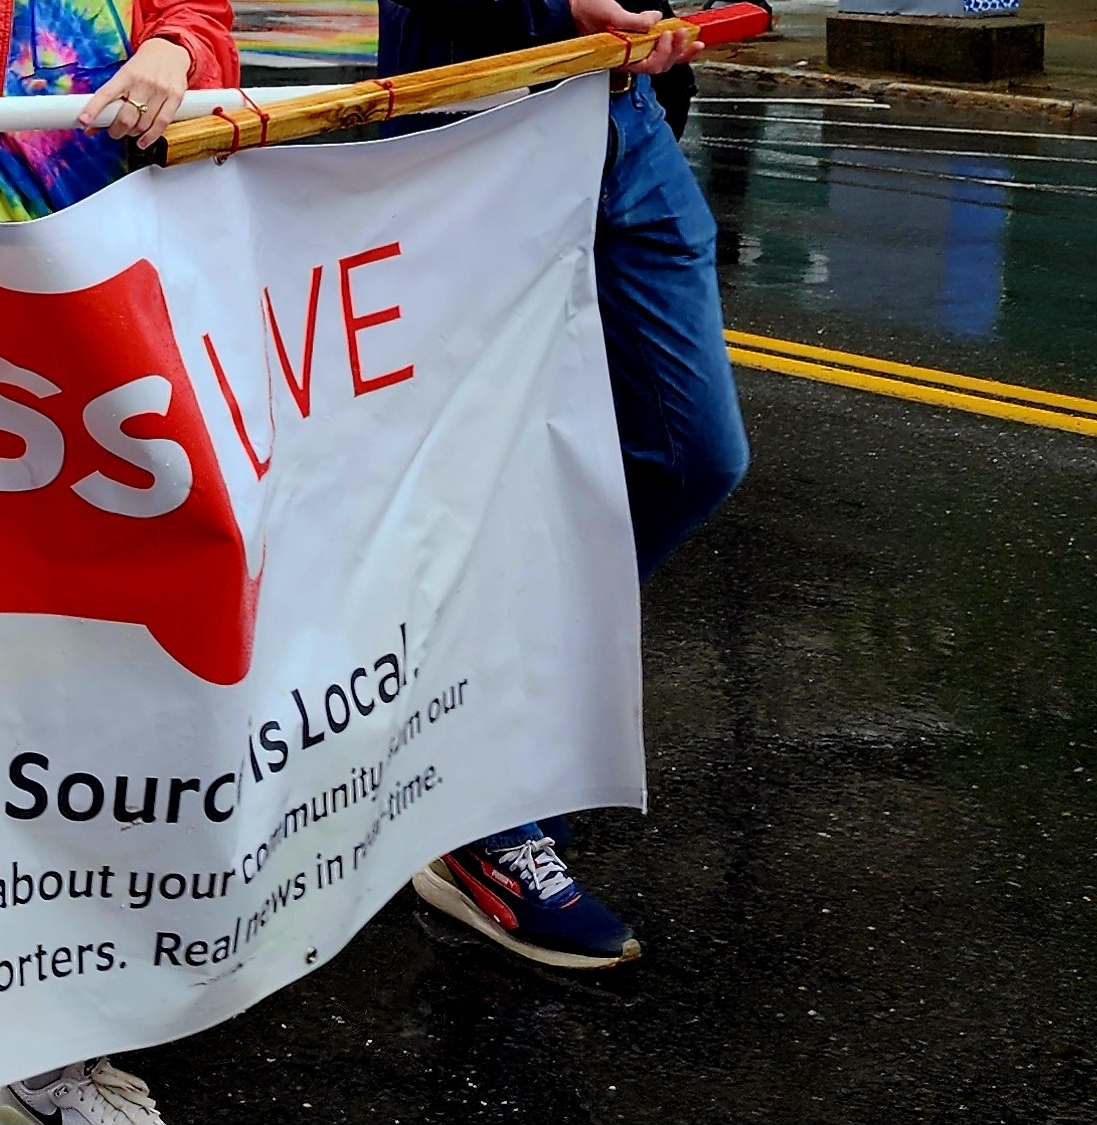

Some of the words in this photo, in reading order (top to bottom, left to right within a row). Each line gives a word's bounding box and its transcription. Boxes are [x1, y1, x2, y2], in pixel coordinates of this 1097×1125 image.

[202, 241, 415, 482] LVE
[5, 751, 244, 824] Sourc
[291, 622, 420, 750] Local.
[128, 865, 237, 909] your
[242, 761, 383, 885] comunity
[428, 678, 469, 724] our
[153, 916, 242, 968] Real
[316, 852, 344, 890] in
